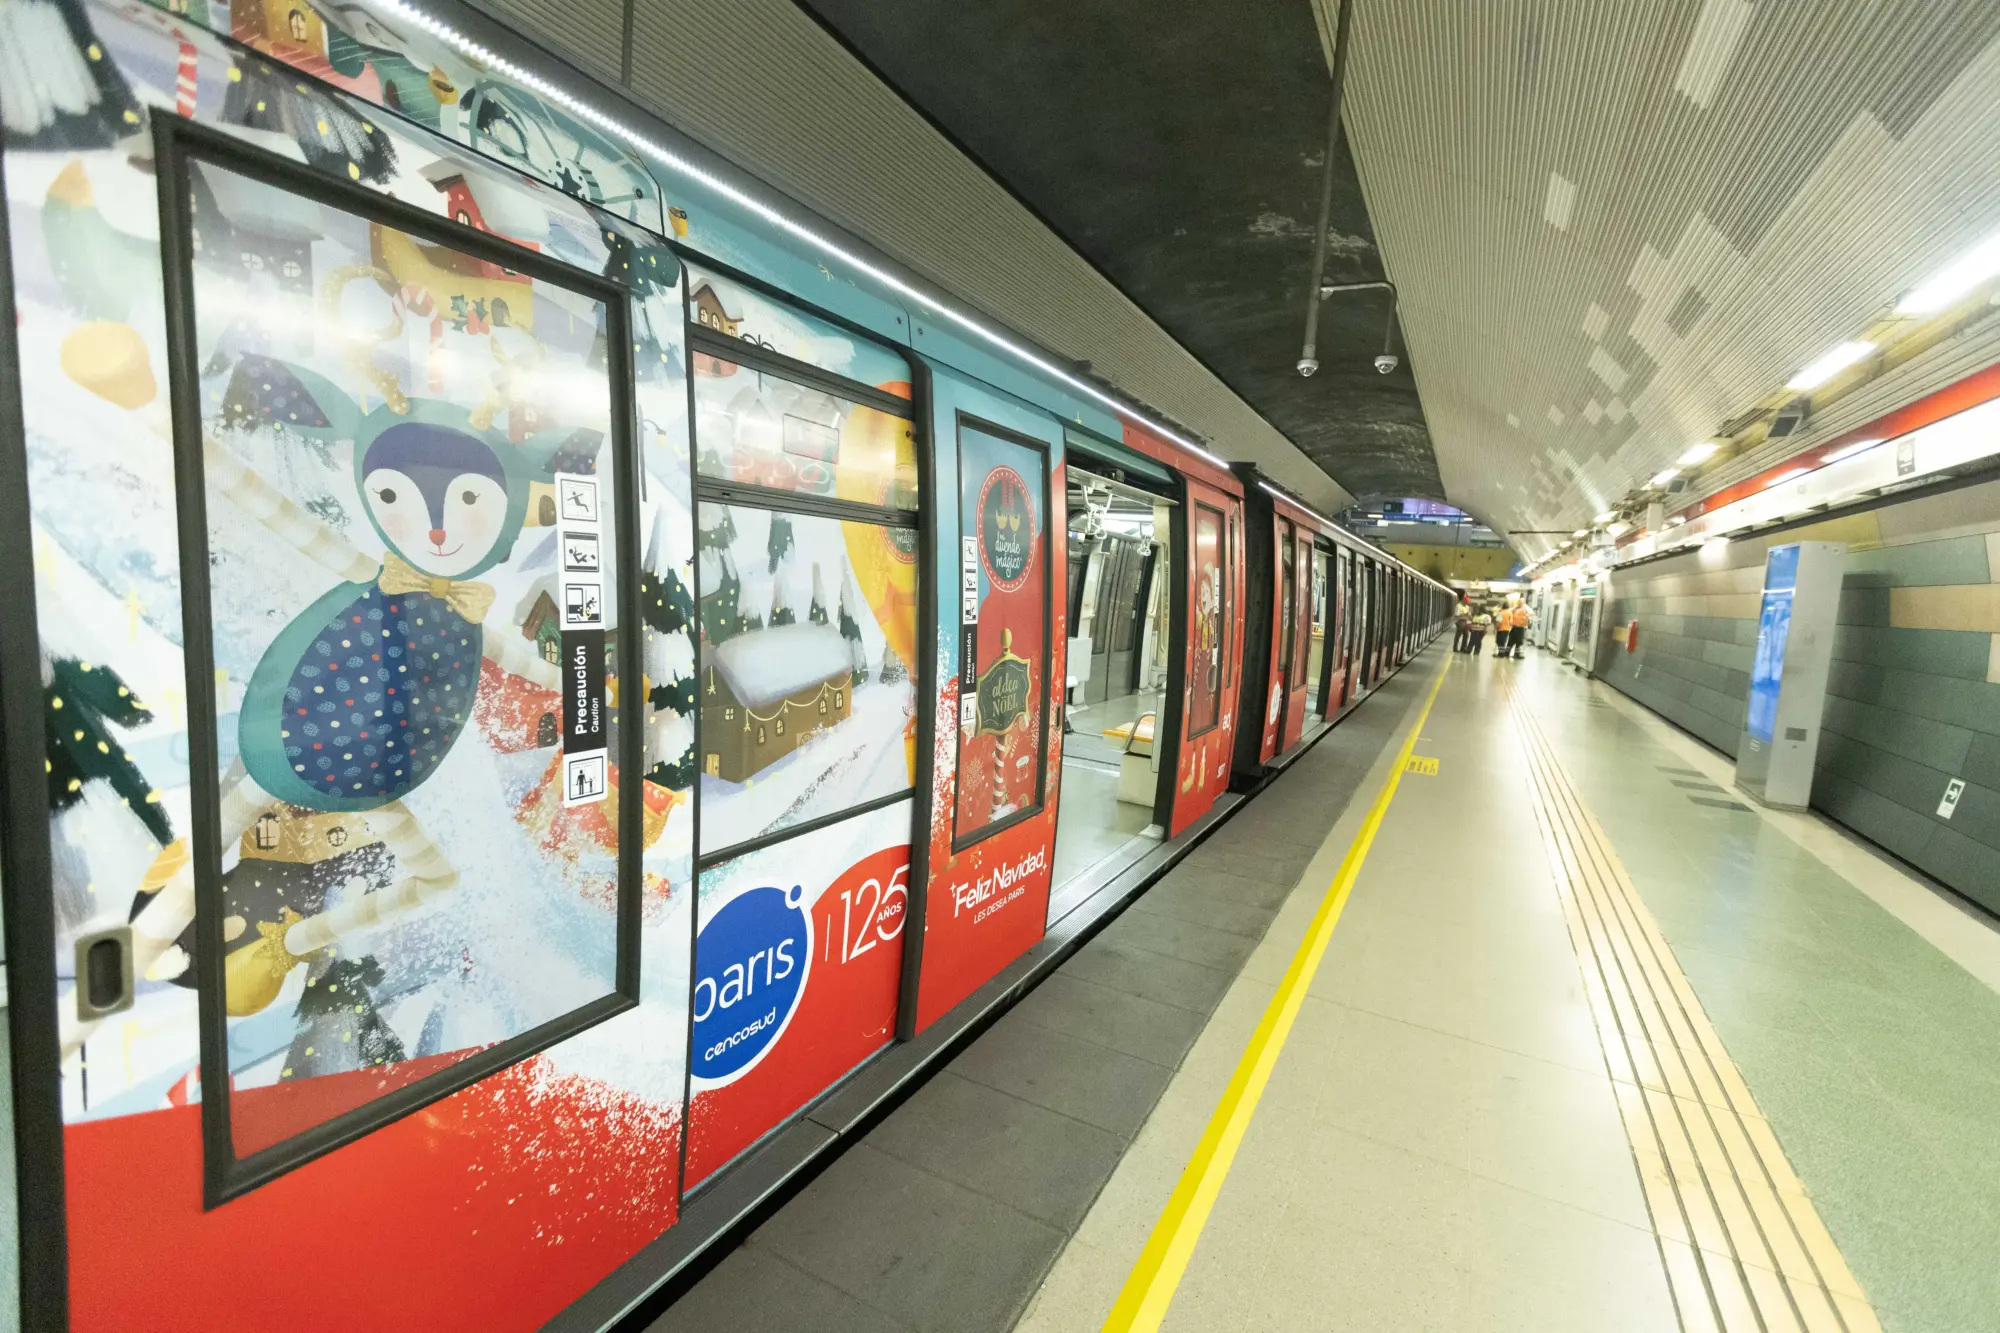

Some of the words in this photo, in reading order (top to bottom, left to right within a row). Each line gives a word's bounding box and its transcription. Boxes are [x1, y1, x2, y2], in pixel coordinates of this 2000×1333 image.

[996, 553, 1021, 578] mágico
[574, 645, 587, 736] Precaución
[992, 672, 1018, 698] aldea
[591, 697, 599, 734] Caution
[954, 878, 992, 918] Feliz
[991, 844, 1045, 895] Navidad
[840, 863, 911, 965] 125
[876, 901, 902, 923] AÑOS
[973, 910, 987, 925] LES
[986, 896, 1008, 917] DESEA
[1007, 884, 1026, 903] PARIS
[705, 1006, 776, 1062] cencosud
